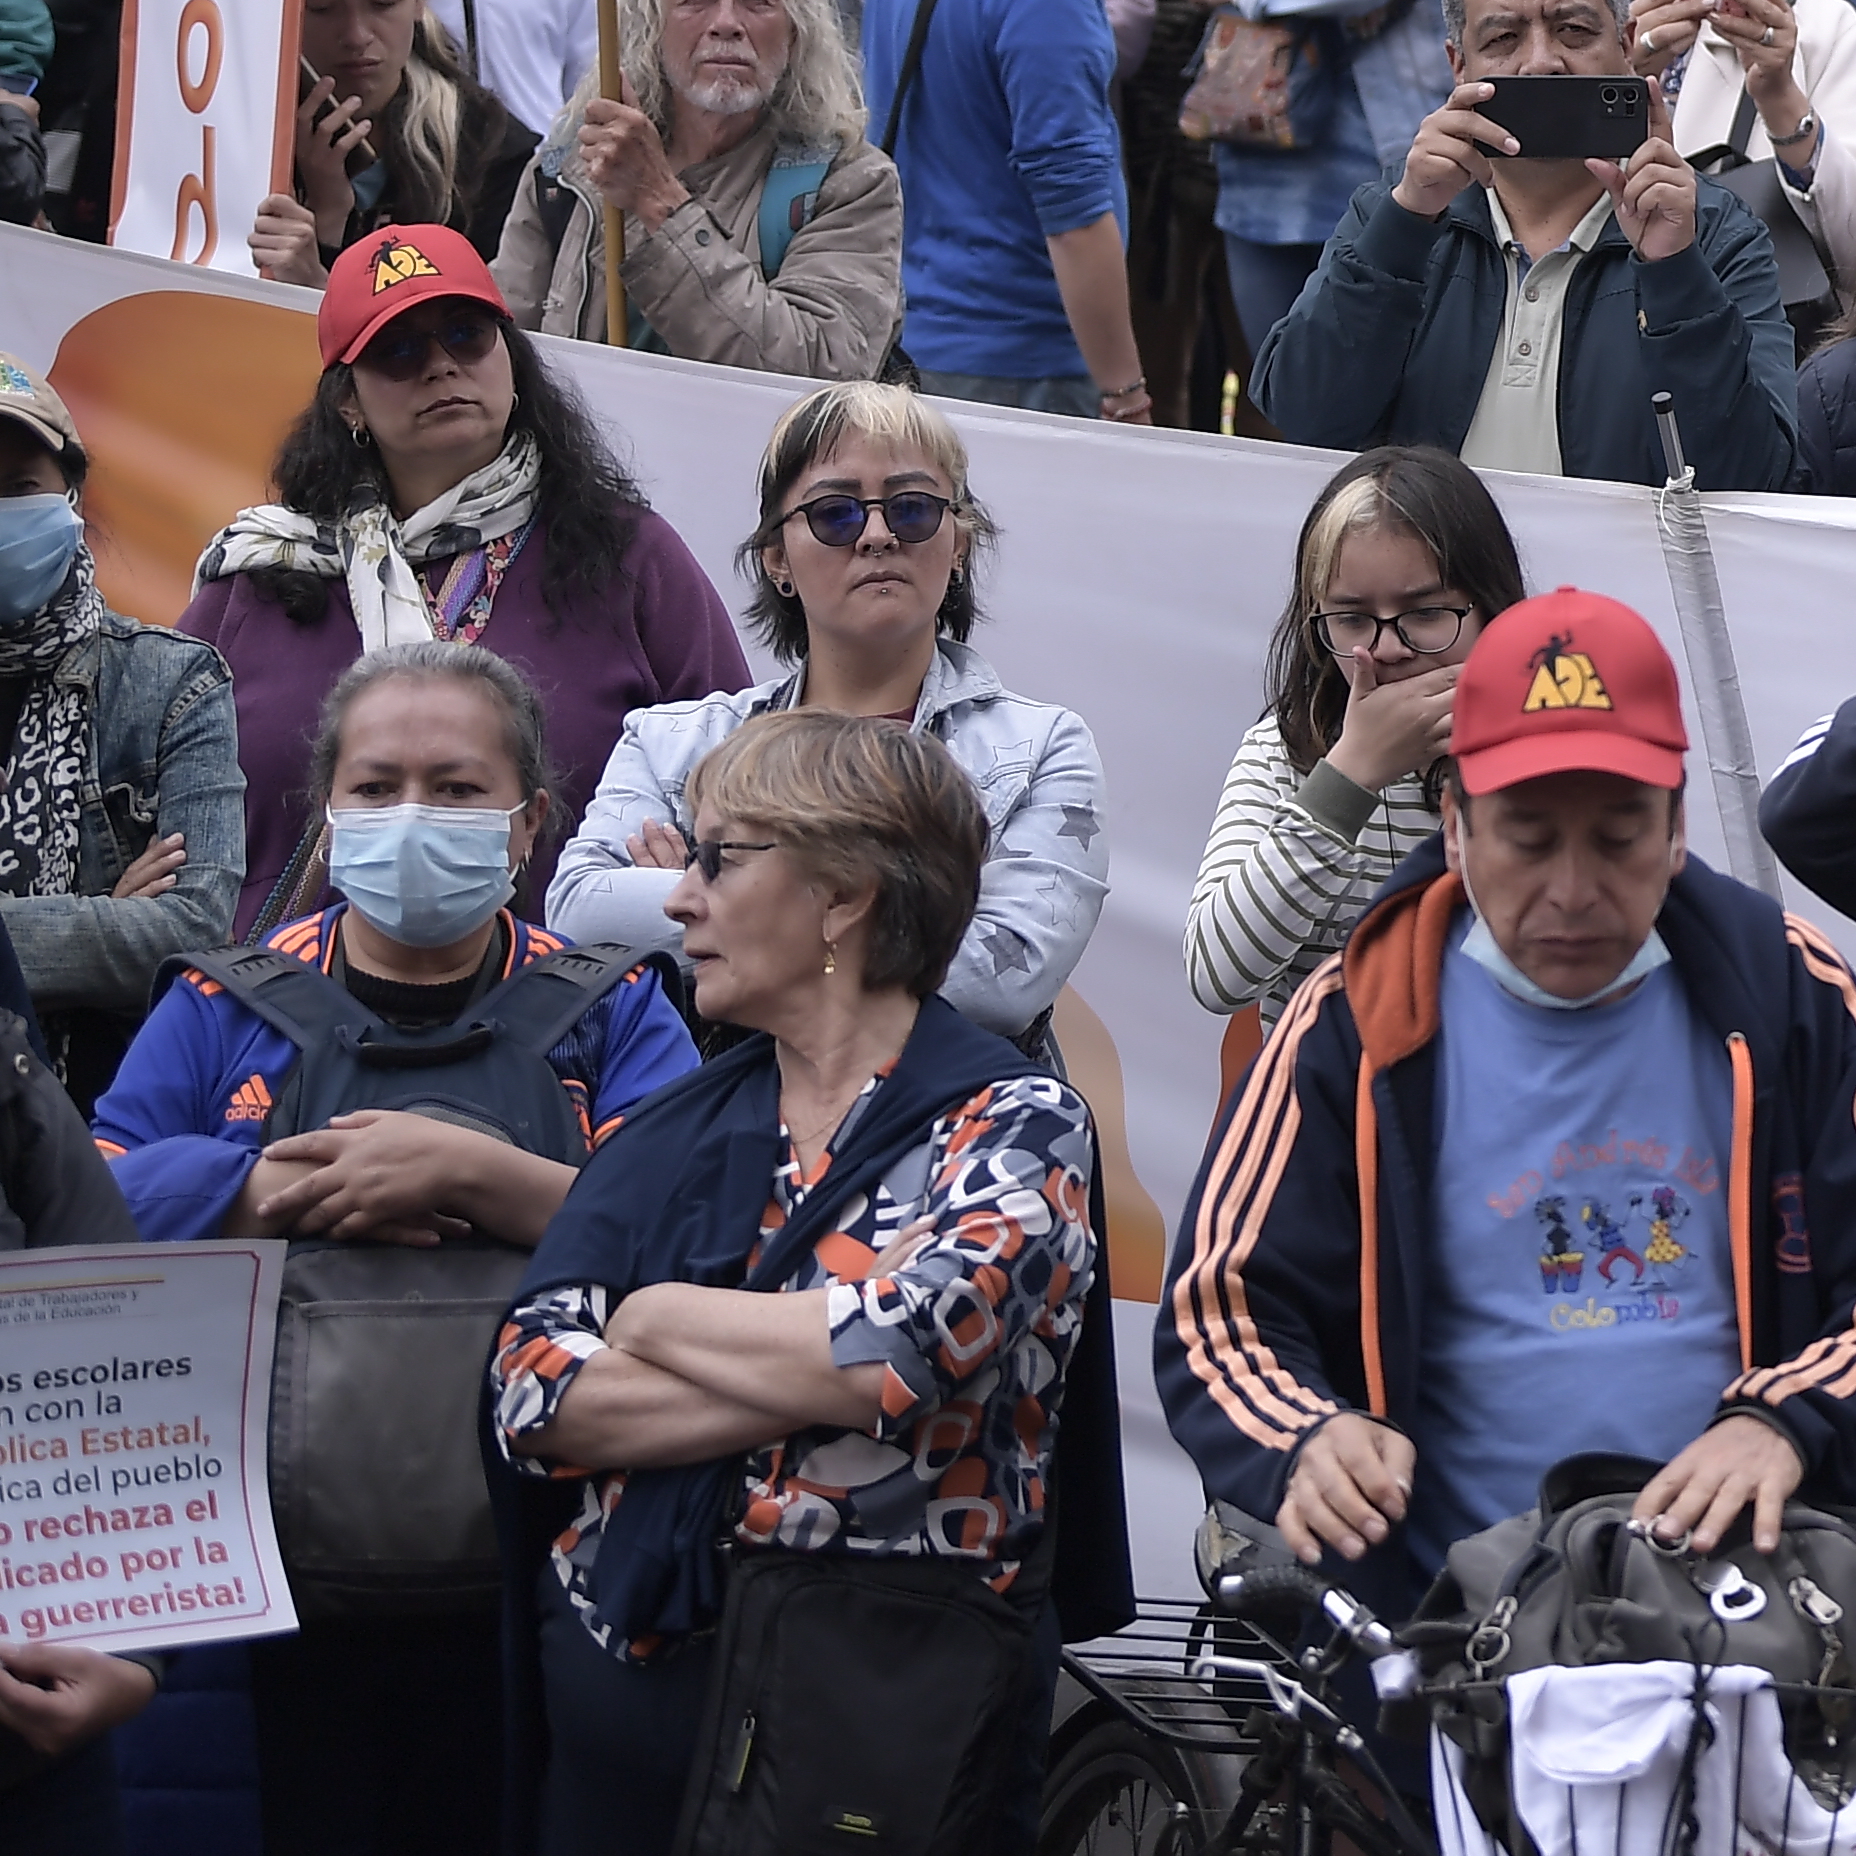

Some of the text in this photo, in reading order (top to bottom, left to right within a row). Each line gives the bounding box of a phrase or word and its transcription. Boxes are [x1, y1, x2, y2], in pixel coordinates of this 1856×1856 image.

[371, 243, 443, 297] ADE
[1520, 651, 1615, 714] ADE
[33, 1355, 193, 1391] escolares
[25, 1396, 85, 1424] con
[96, 1391, 123, 1416] la
[80, 1415, 212, 1457] Estatal,
[52, 1465, 101, 1496] del
[112, 1453, 224, 1496] pueblo
[24, 1503, 175, 1544] rechaza
[184, 1489, 219, 1521] el
[120, 1543, 184, 1582] por
[193, 1535, 229, 1566] la
[20, 1575, 248, 1640] guerrerista!
